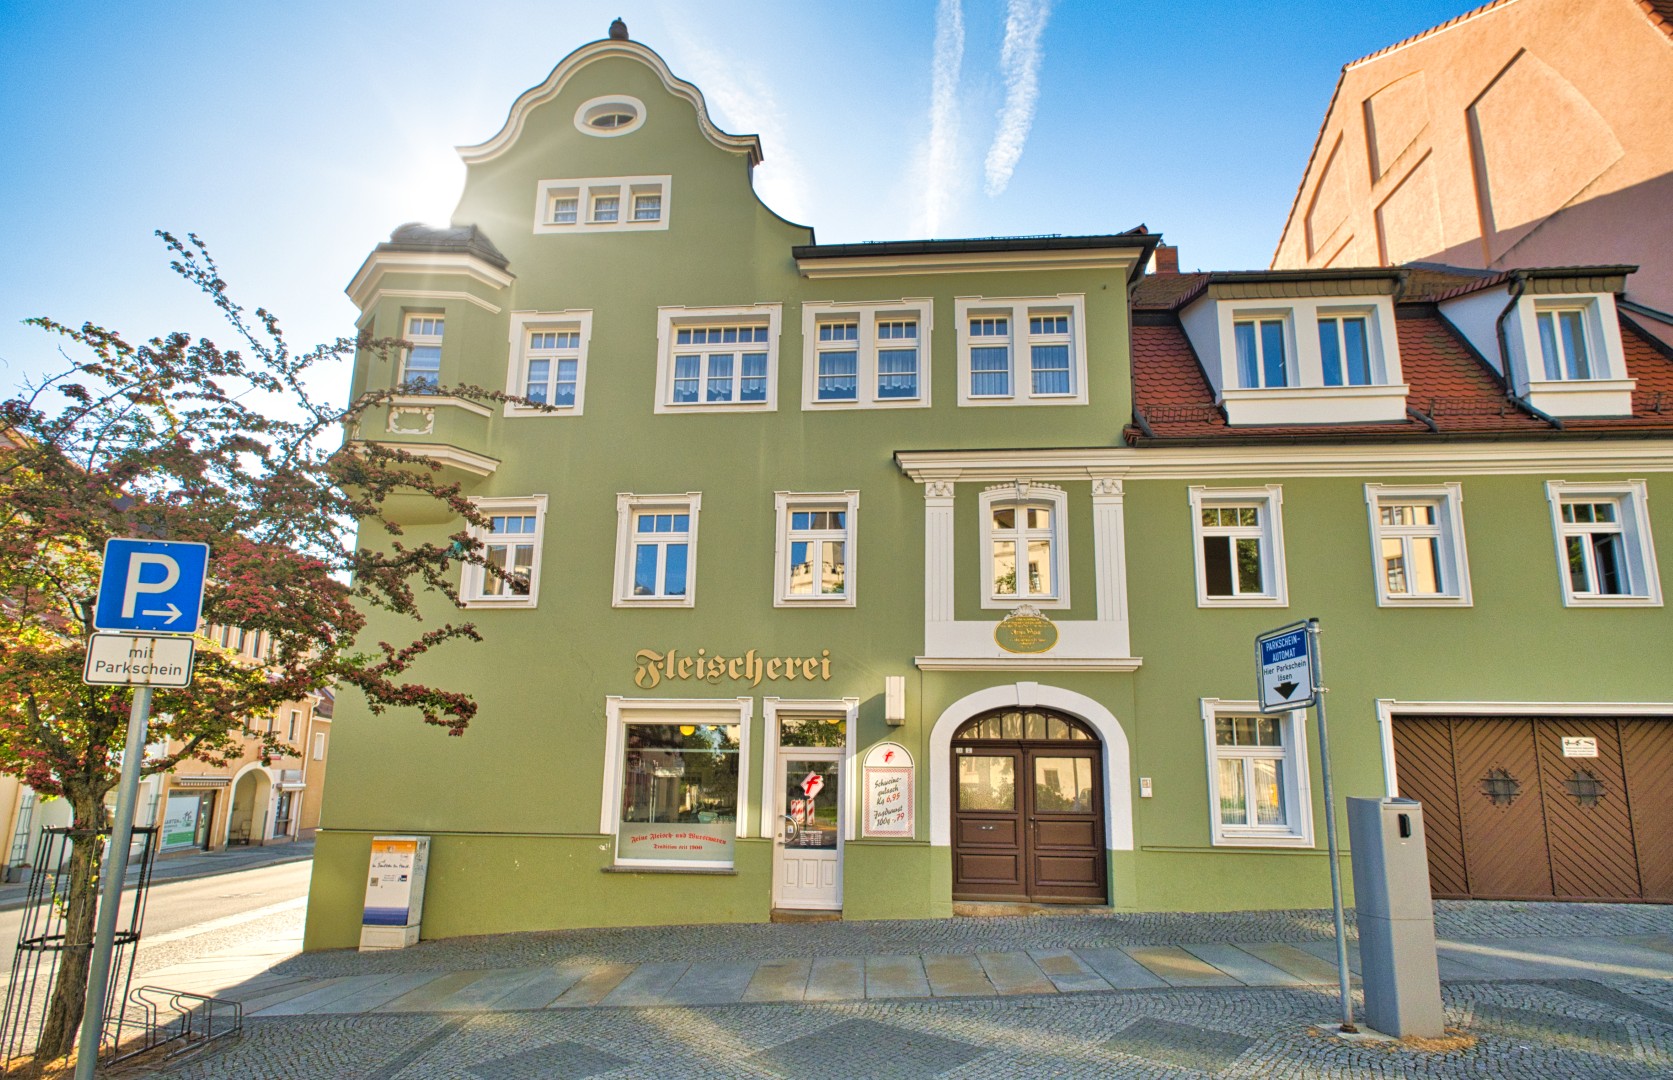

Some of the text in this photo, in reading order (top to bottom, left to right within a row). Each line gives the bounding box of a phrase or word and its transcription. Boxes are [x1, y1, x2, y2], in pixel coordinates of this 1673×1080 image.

[121, 552, 180, 618] P
[1265, 634, 1301, 652] PARKSCHEIN-
[128, 646, 154, 659] mit
[1272, 647, 1296, 662] AUTOMAT
[95, 660, 182, 676] Parkschein
[633, 648, 832, 690] Fleischerei
[1263, 659, 1307, 676] Hier Parkschein
[1277, 673, 1293, 682] lösen
[630, 835, 648, 844] Feine
